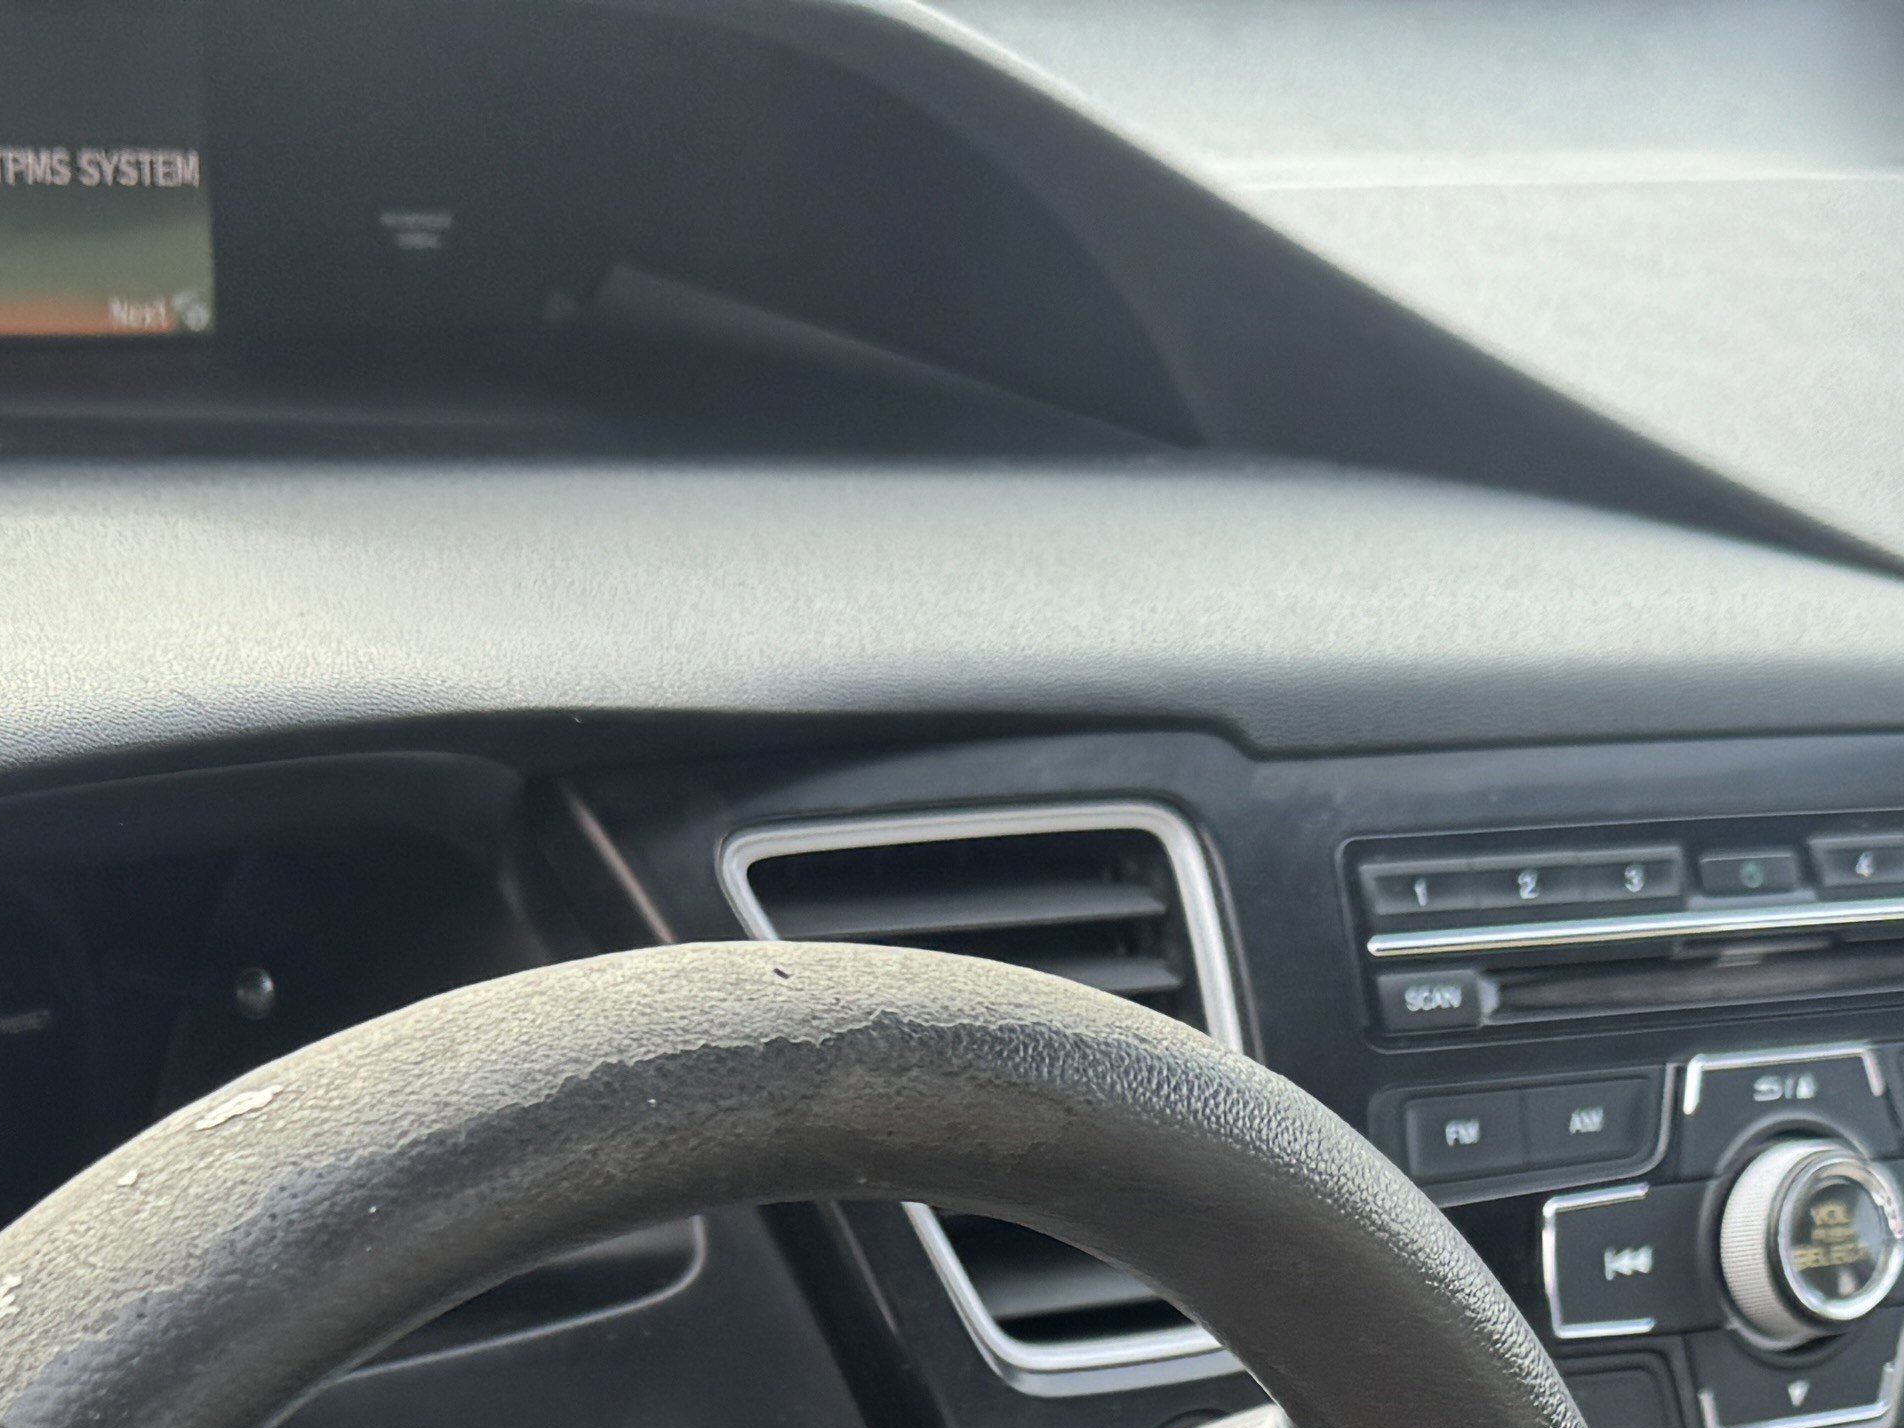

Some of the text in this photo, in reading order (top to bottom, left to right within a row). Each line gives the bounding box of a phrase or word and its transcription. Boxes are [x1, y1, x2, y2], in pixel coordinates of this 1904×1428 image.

[77, 146, 200, 188] SYSTEM
[1624, 864, 1645, 893] 3
[1855, 851, 1875, 878] 4
[1414, 877, 1428, 906] 1
[1517, 869, 1540, 899] 2
[1405, 984, 1462, 1011] SCAN
